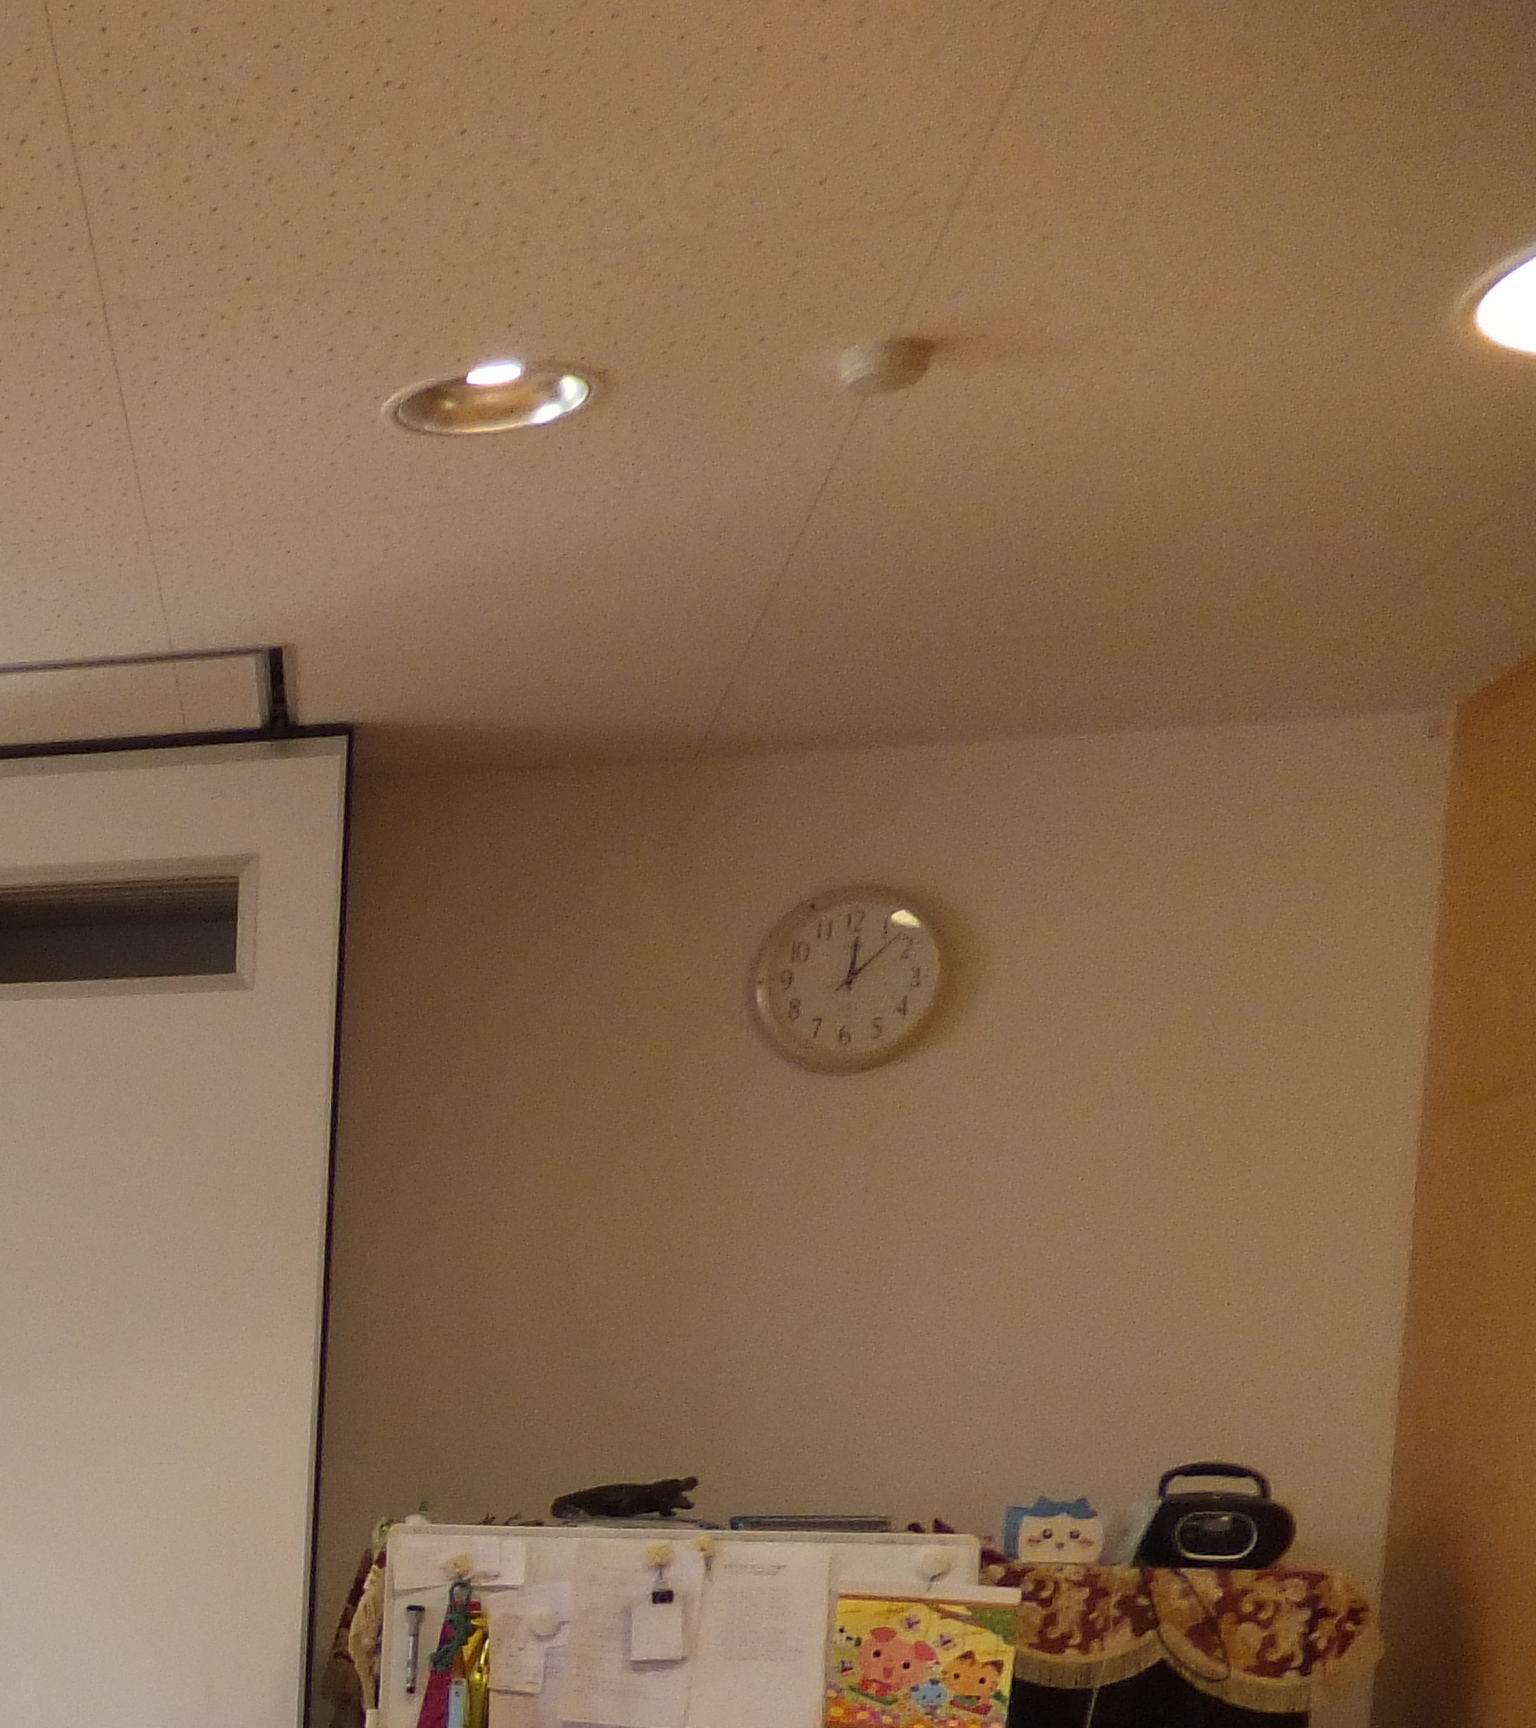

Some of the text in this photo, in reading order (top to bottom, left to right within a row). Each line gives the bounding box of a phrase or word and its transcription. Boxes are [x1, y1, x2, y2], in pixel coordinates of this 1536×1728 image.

[817, 919, 833, 940] 11
[846, 910, 865, 933] 12
[791, 940, 811, 962] 10
[788, 997, 802, 1021] 8
[812, 1017, 823, 1039] 7
[838, 1025, 852, 1046] 6
[872, 1016, 883, 1039] 5
